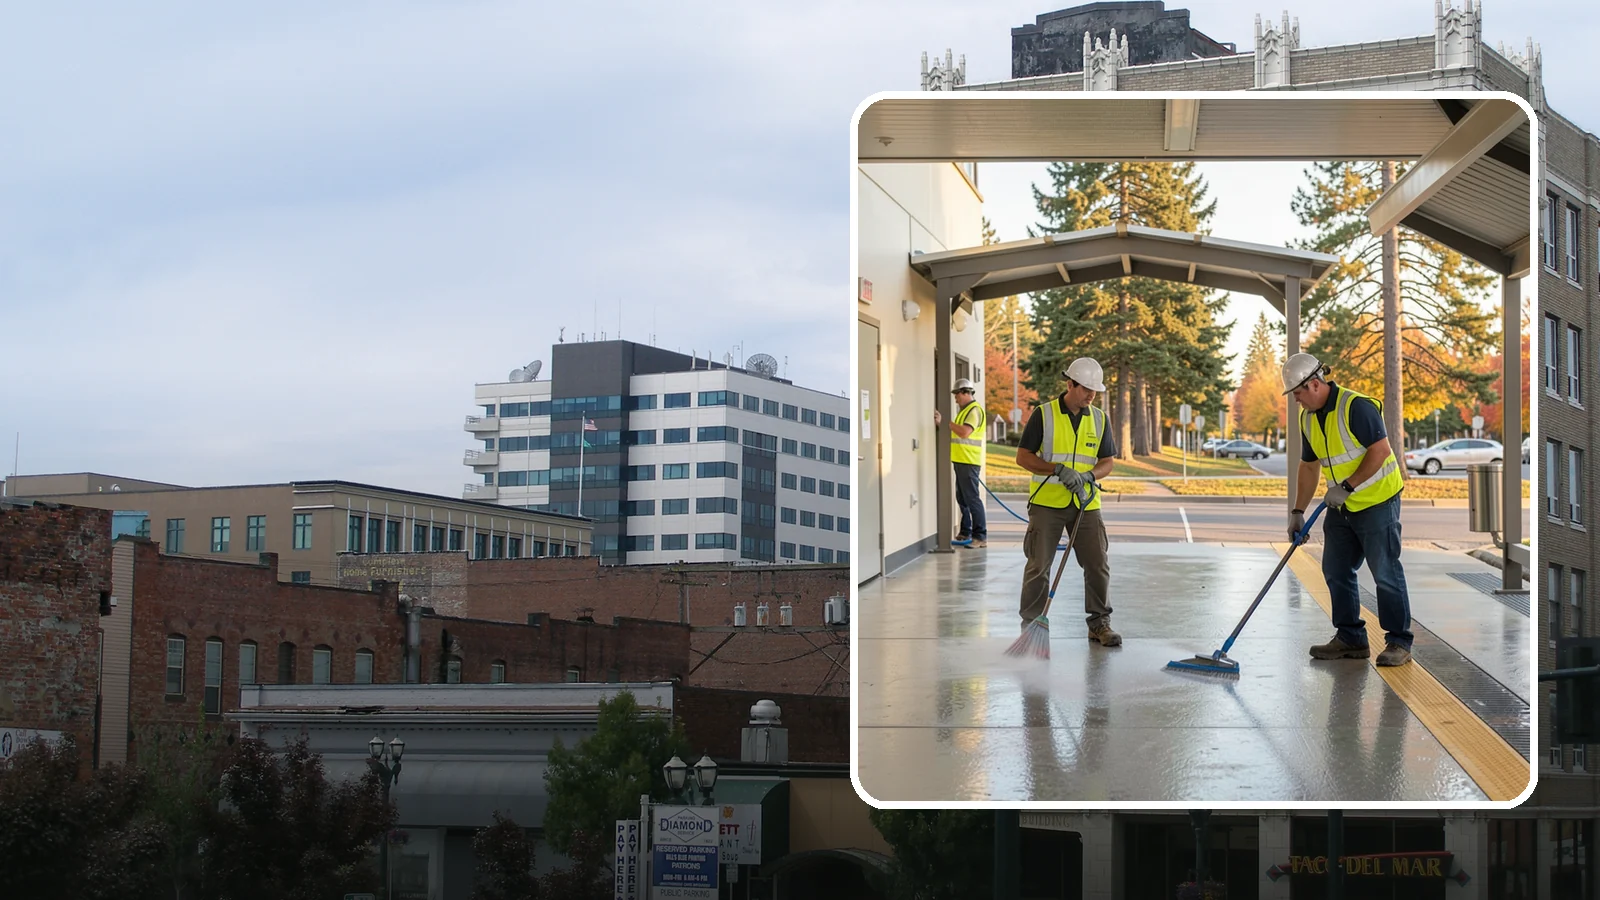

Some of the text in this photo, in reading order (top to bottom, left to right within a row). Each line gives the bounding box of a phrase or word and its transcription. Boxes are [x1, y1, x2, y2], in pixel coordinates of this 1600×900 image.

[660, 818, 713, 833] DIAMOND
[1022, 814, 1070, 828] BUILDING
[655, 845, 716, 854] RESERVED PARKING
[721, 851, 739, 862] Soup
[616, 825, 625, 893] PAY HERE
[627, 824, 636, 893] PAY HERE
[671, 862, 701, 870] PATRONS
[1289, 855, 1442, 877] TAC DEL MAR
[660, 889, 710, 898] PUBLIC PARKING
